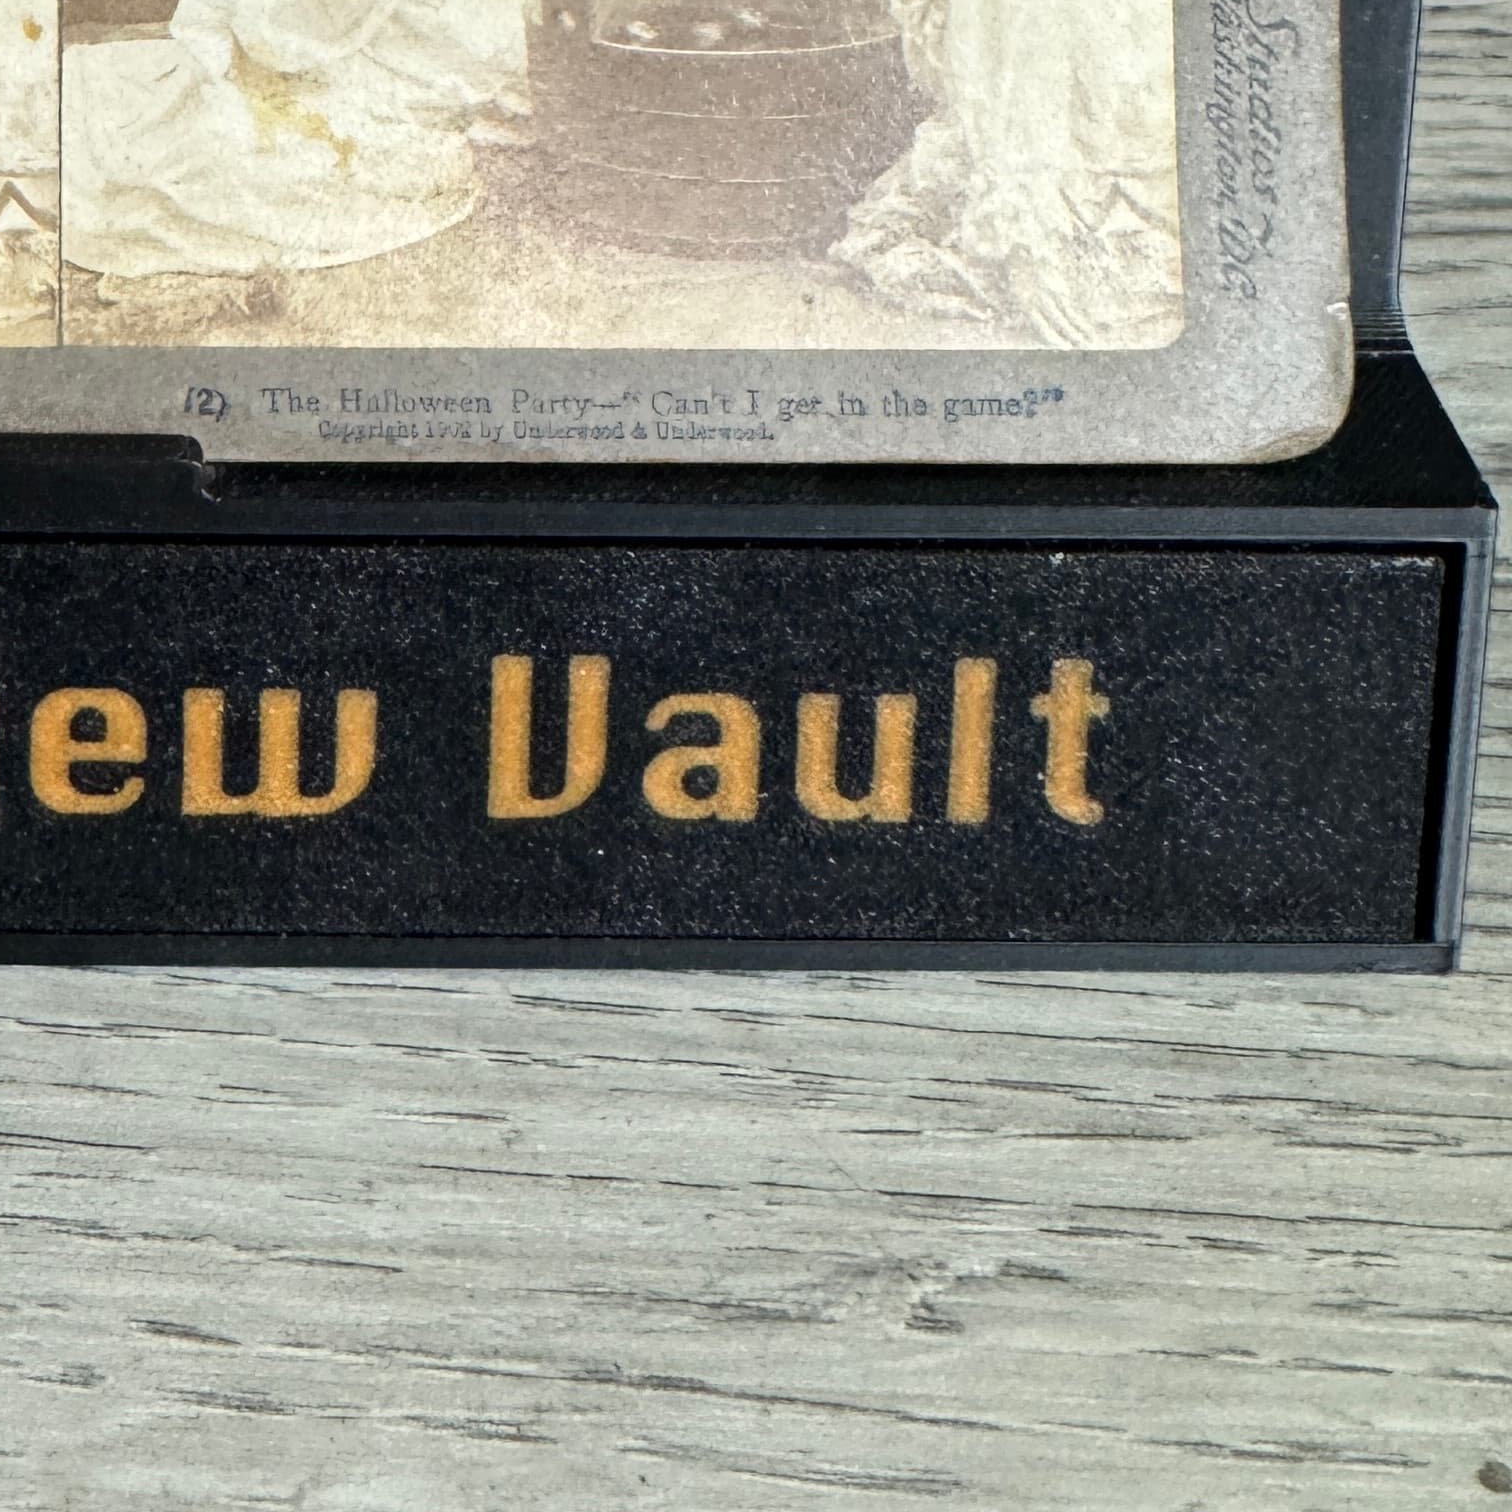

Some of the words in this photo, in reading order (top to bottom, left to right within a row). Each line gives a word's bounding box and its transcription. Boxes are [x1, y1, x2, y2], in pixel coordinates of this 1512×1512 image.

[261, 388, 320, 413] The
[340, 388, 493, 413] Halloween
[745, 390, 761, 415] I
[838, 390, 866, 416] in
[884, 389, 928, 417] the
[488, 653, 1112, 827] Vault
